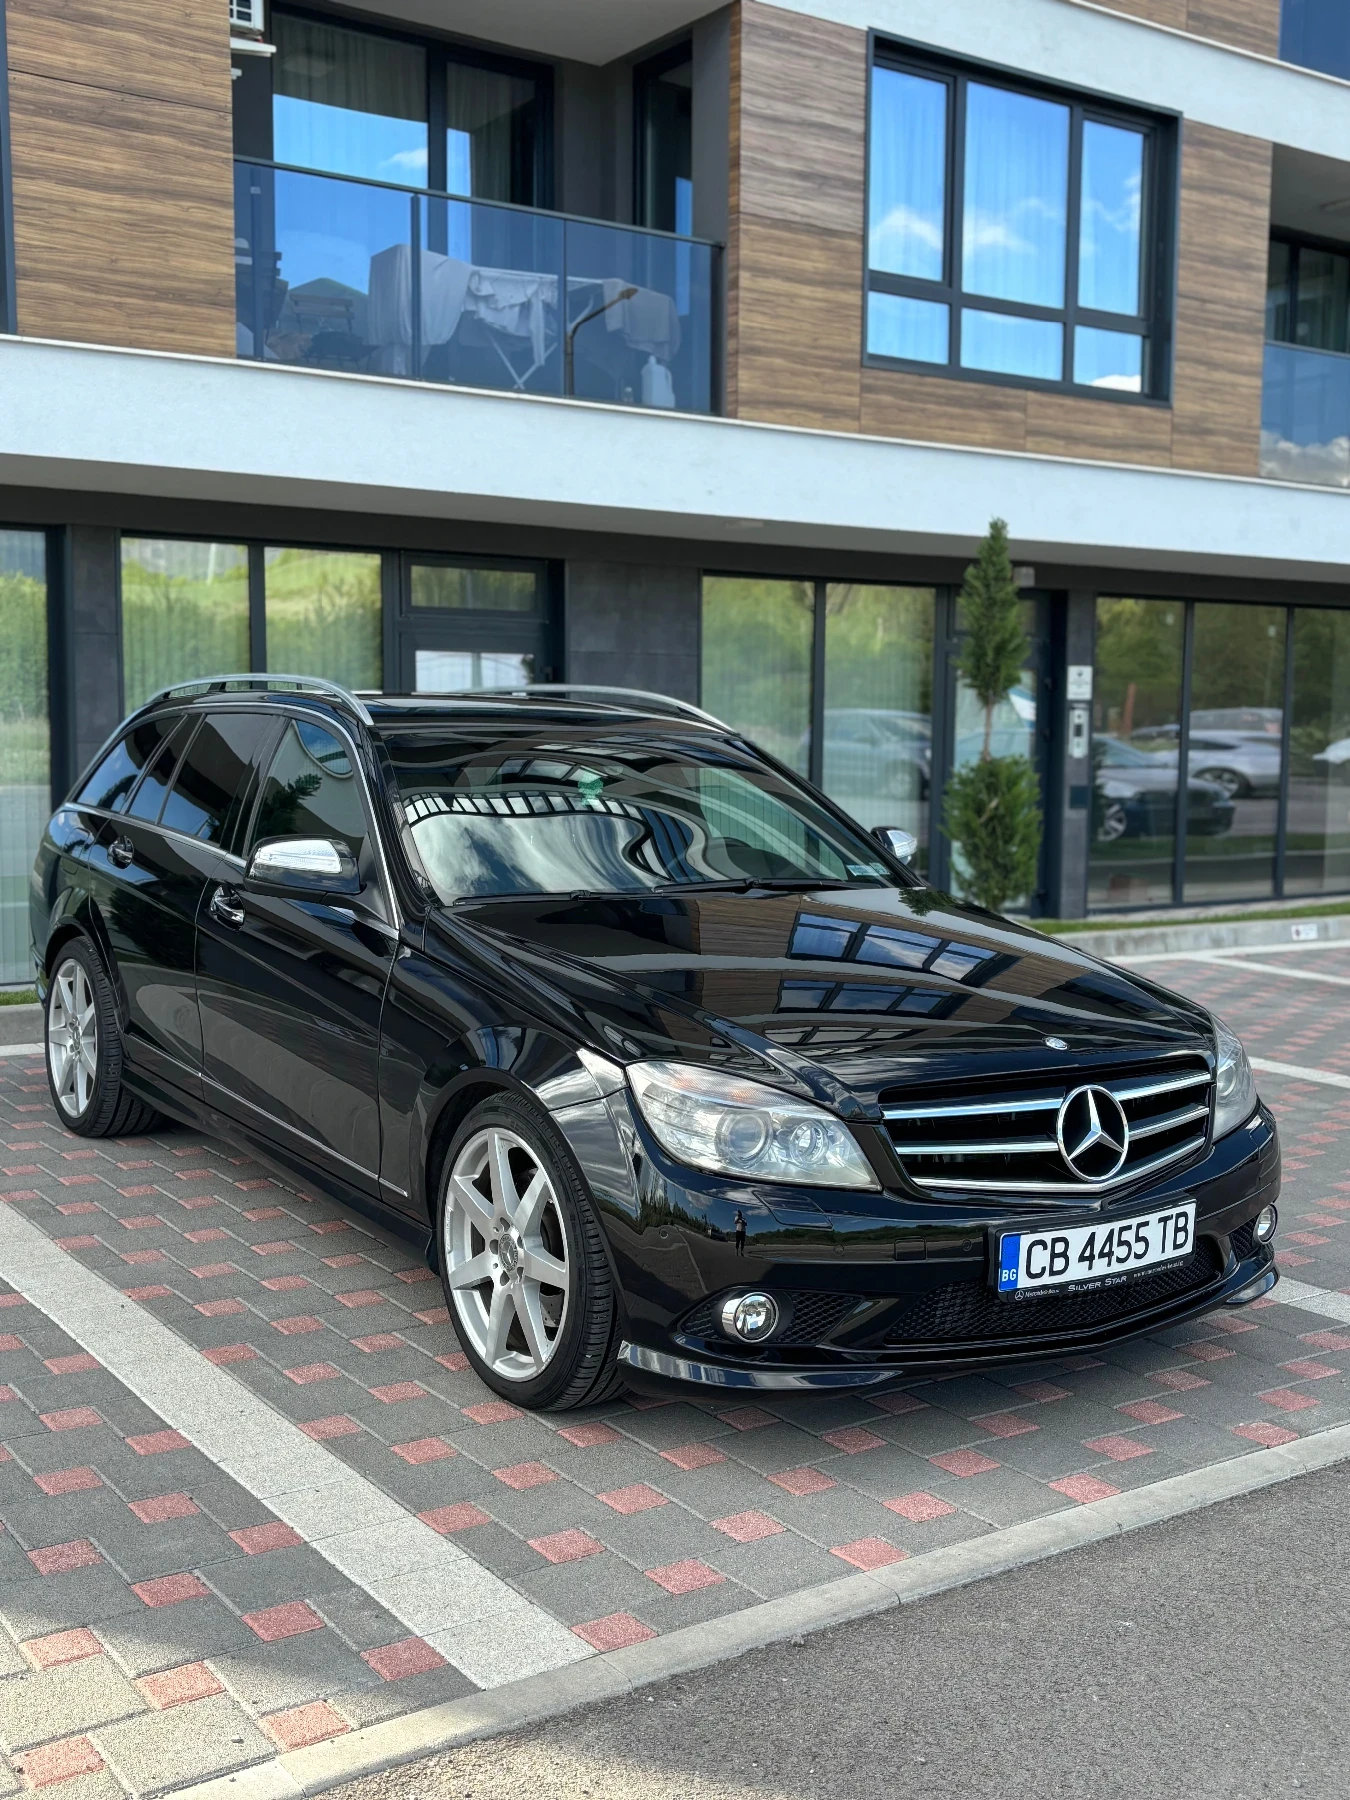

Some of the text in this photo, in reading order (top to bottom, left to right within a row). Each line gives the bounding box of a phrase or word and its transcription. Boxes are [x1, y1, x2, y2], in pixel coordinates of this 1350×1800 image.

[1026, 1236, 1070, 1279] CB
[1078, 1221, 1150, 1271] 4455
[1157, 1211, 1189, 1254] TB
[1001, 1269, 1017, 1282] BG
[1067, 1281, 1102, 1292] SILVER
[1105, 1275, 1127, 1286] STAR
